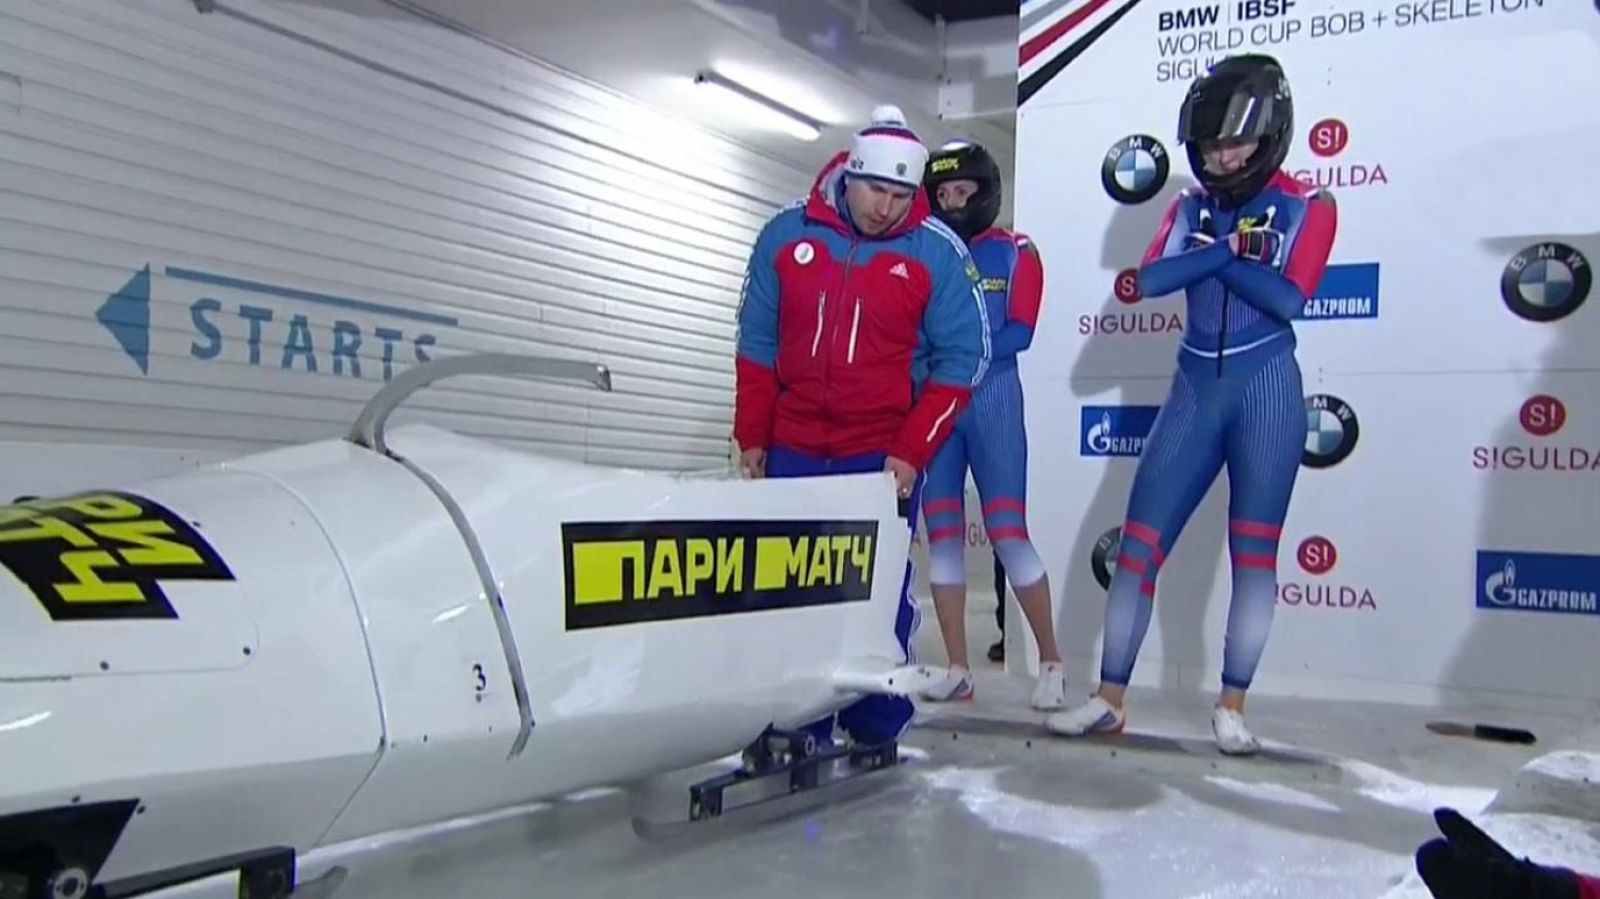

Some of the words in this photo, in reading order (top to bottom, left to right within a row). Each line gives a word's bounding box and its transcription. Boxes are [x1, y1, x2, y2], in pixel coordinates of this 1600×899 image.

[1158, 5, 1220, 32] BMW
[1237, 0, 1296, 21] IBSF
[1157, 28, 1244, 58] WORLD
[1250, 20, 1302, 46] CUP
[1310, 11, 1365, 37] BOB
[1108, 136, 1164, 161] BMW
[1286, 164, 1388, 188] GULDA
[1510, 245, 1584, 272] BMW
[1303, 297, 1371, 317] GAZPROM
[1312, 396, 1353, 421] MW
[572, 537, 745, 606] ПАРИ
[754, 536, 872, 592] МАТЧ
[1518, 588, 1597, 612] GAZPROM
